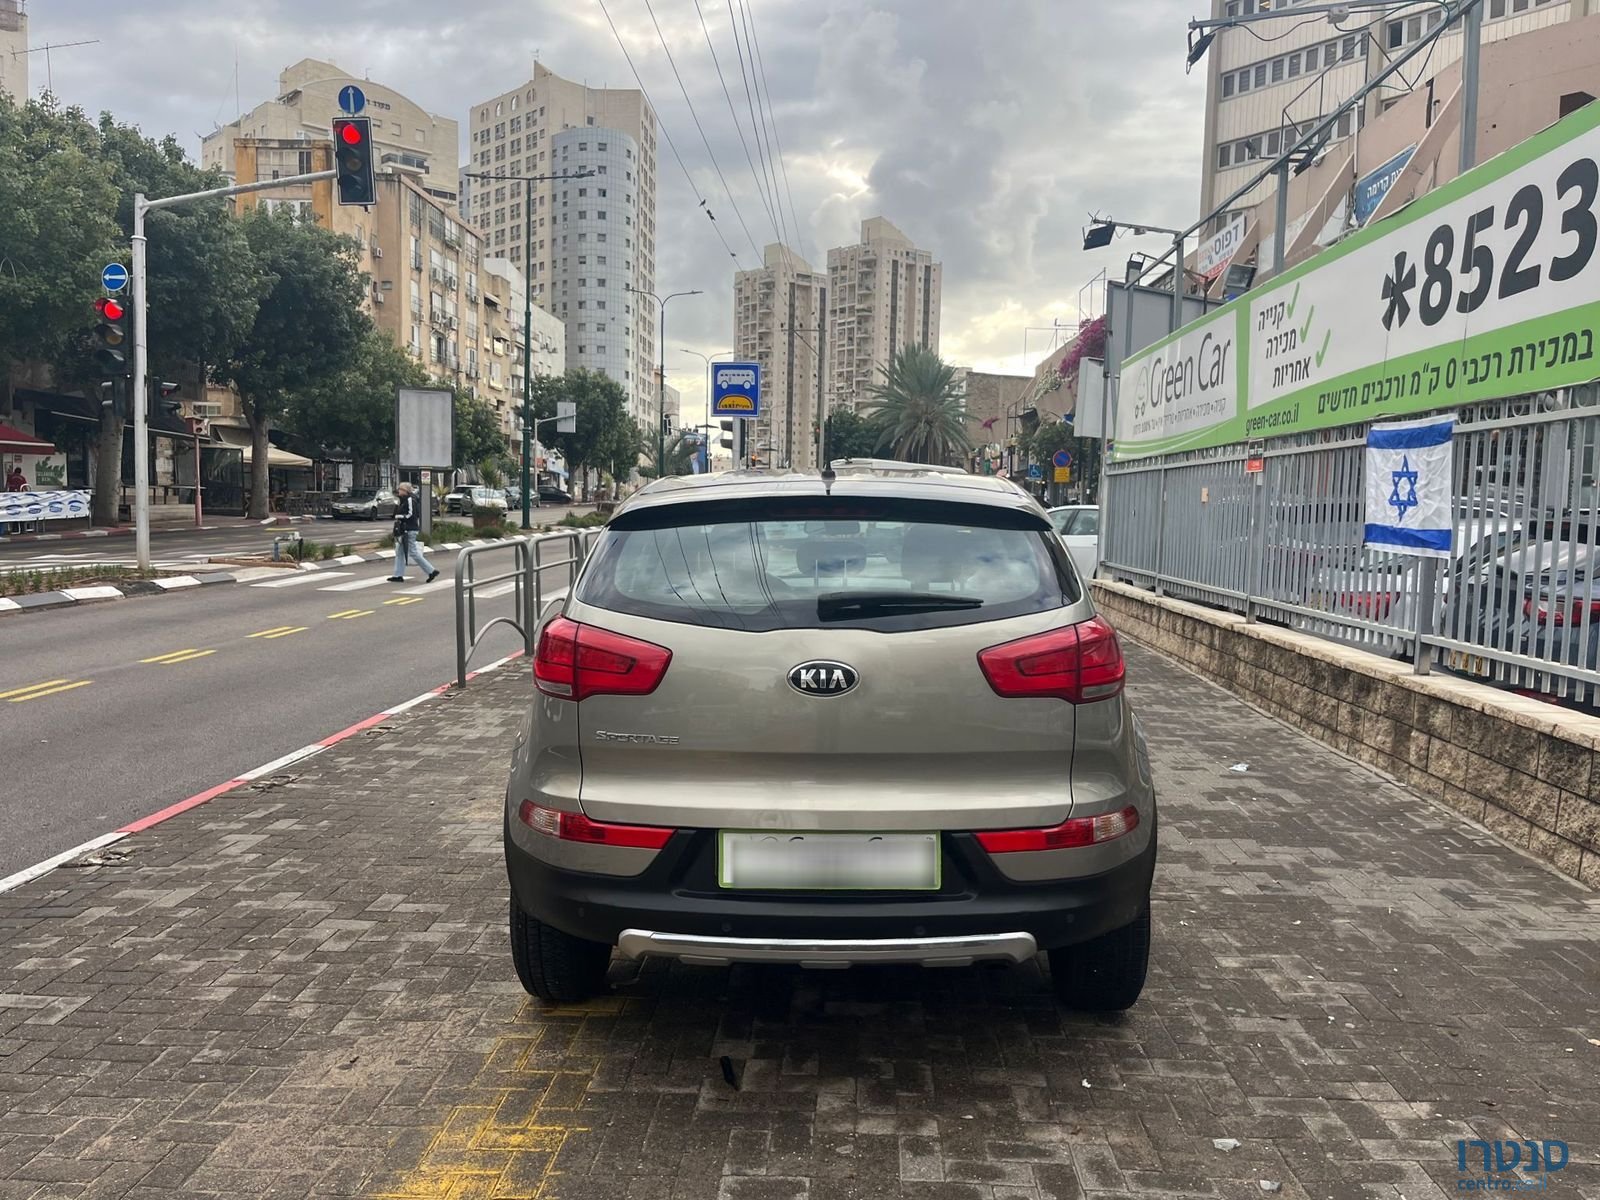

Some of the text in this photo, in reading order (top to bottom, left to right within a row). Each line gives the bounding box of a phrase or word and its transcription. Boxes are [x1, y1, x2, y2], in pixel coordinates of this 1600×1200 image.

[1214, 224, 1240, 255] דפוס
[1258, 301, 1285, 332] קנייה
[1266, 328, 1297, 359] מכירה
[1507, 329, 1594, 377] במכירת
[1150, 332, 1231, 408] Green Car
[1272, 356, 1312, 389] אחריות
[1445, 357, 1457, 389] 0
[1462, 352, 1502, 385] רכבי
[1318, 386, 1358, 414] חדשים
[1361, 374, 1406, 406] ורכבים
[1246, 402, 1300, 437] green-car.co.il
[799, 668, 848, 689] KIA
